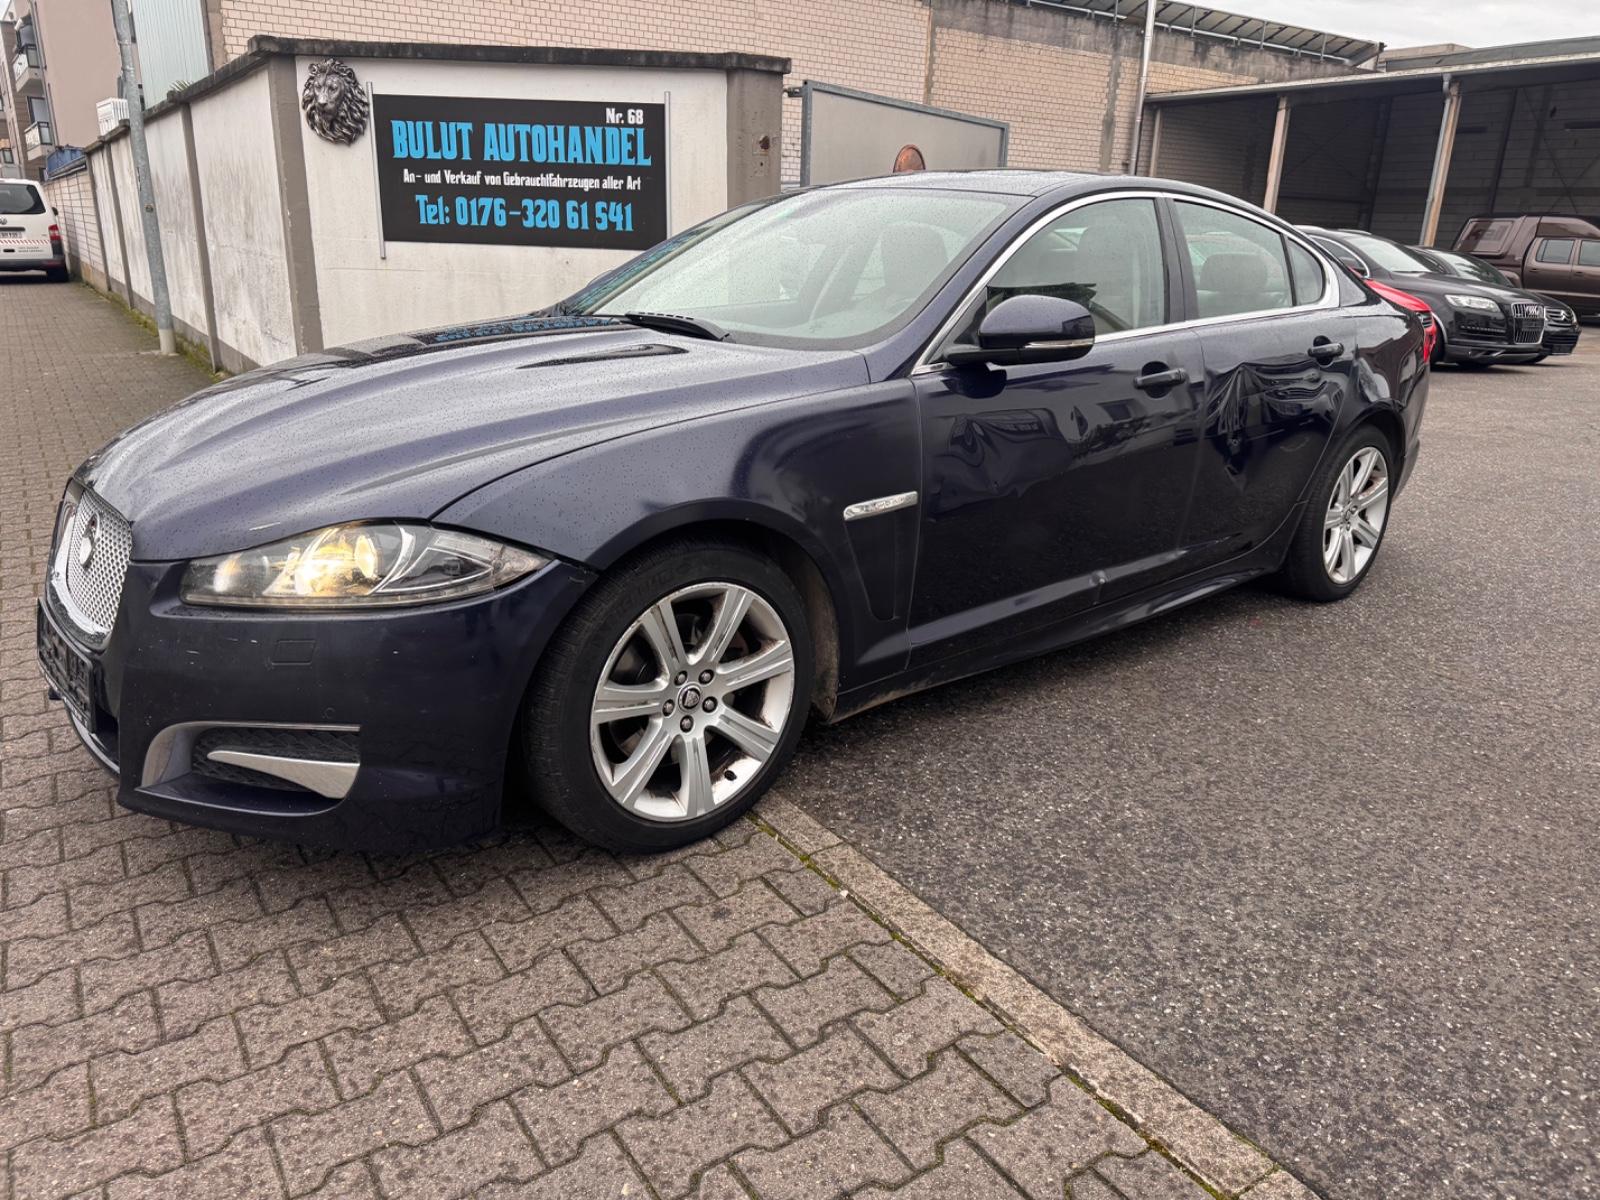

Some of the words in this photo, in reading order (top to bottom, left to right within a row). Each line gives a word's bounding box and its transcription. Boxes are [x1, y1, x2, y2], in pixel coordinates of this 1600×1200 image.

[606, 108, 625, 124] Nr.
[627, 108, 644, 124] 68
[390, 119, 473, 161] BULUT
[483, 122, 652, 166] AUTOHANDEL
[403, 168, 422, 184] An-
[424, 170, 442, 185] und
[444, 169, 482, 186] Verkauf
[484, 173, 501, 186] von
[502, 171, 600, 192] Gebrauchtfahrzeugen
[602, 175, 624, 190] aller
[626, 175, 642, 191] Art
[415, 194, 450, 225] Tel:
[455, 196, 561, 230] 0176-320
[566, 199, 590, 231] 61
[595, 200, 634, 232] 541
